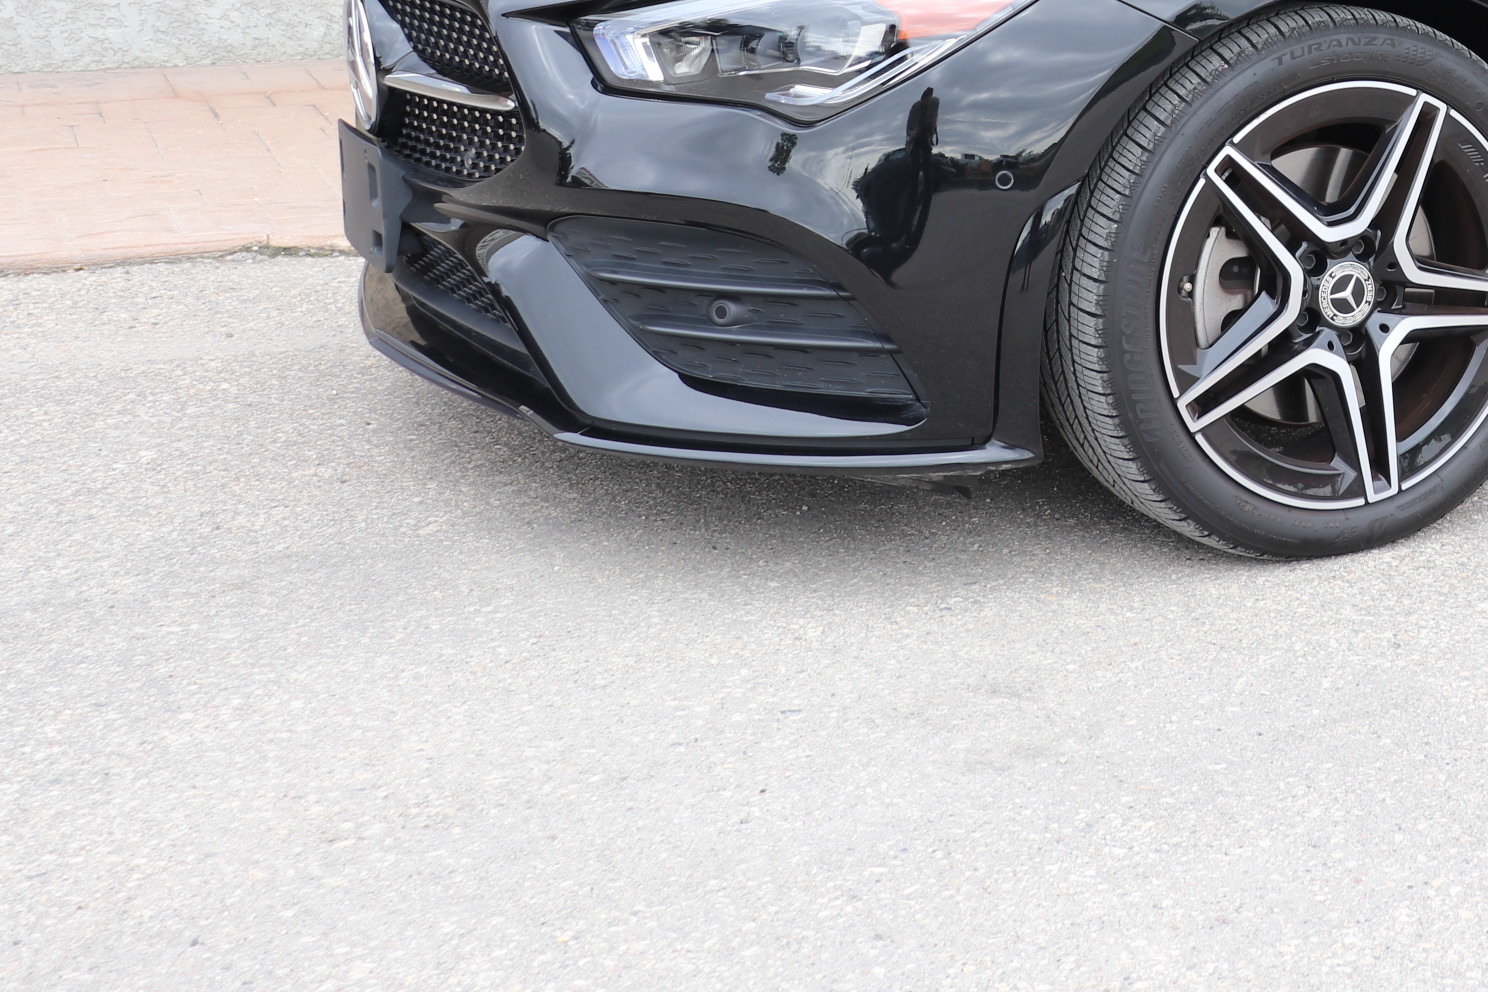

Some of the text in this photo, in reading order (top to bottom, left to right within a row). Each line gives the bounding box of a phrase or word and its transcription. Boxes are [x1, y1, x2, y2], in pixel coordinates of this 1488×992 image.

[1272, 36, 1398, 66] TURANZA
[1320, 276, 1374, 319] MERCEDES BENZ
